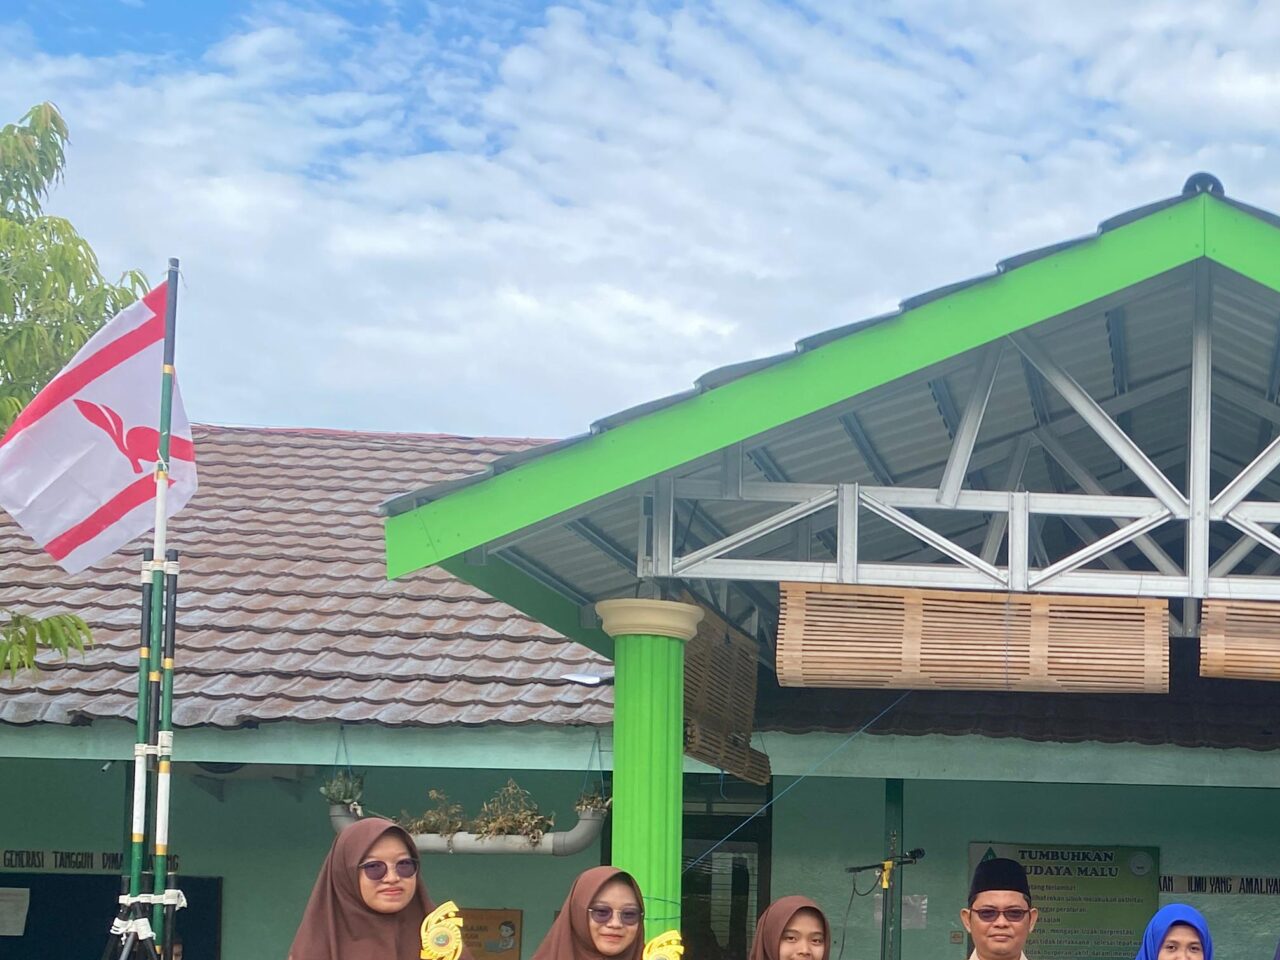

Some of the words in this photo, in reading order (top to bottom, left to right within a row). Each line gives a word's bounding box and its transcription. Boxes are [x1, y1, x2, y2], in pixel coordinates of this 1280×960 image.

[4, 850, 45, 868] GENERASI
[52, 851, 94, 869] TANGGUH
[1018, 850, 1114, 862] TUMBUHKAN
[1025, 865, 1071, 877] UDAYA
[1077, 866, 1119, 878] MALU
[1187, 876, 1208, 893] ILMU
[1209, 876, 1232, 893] YANG
